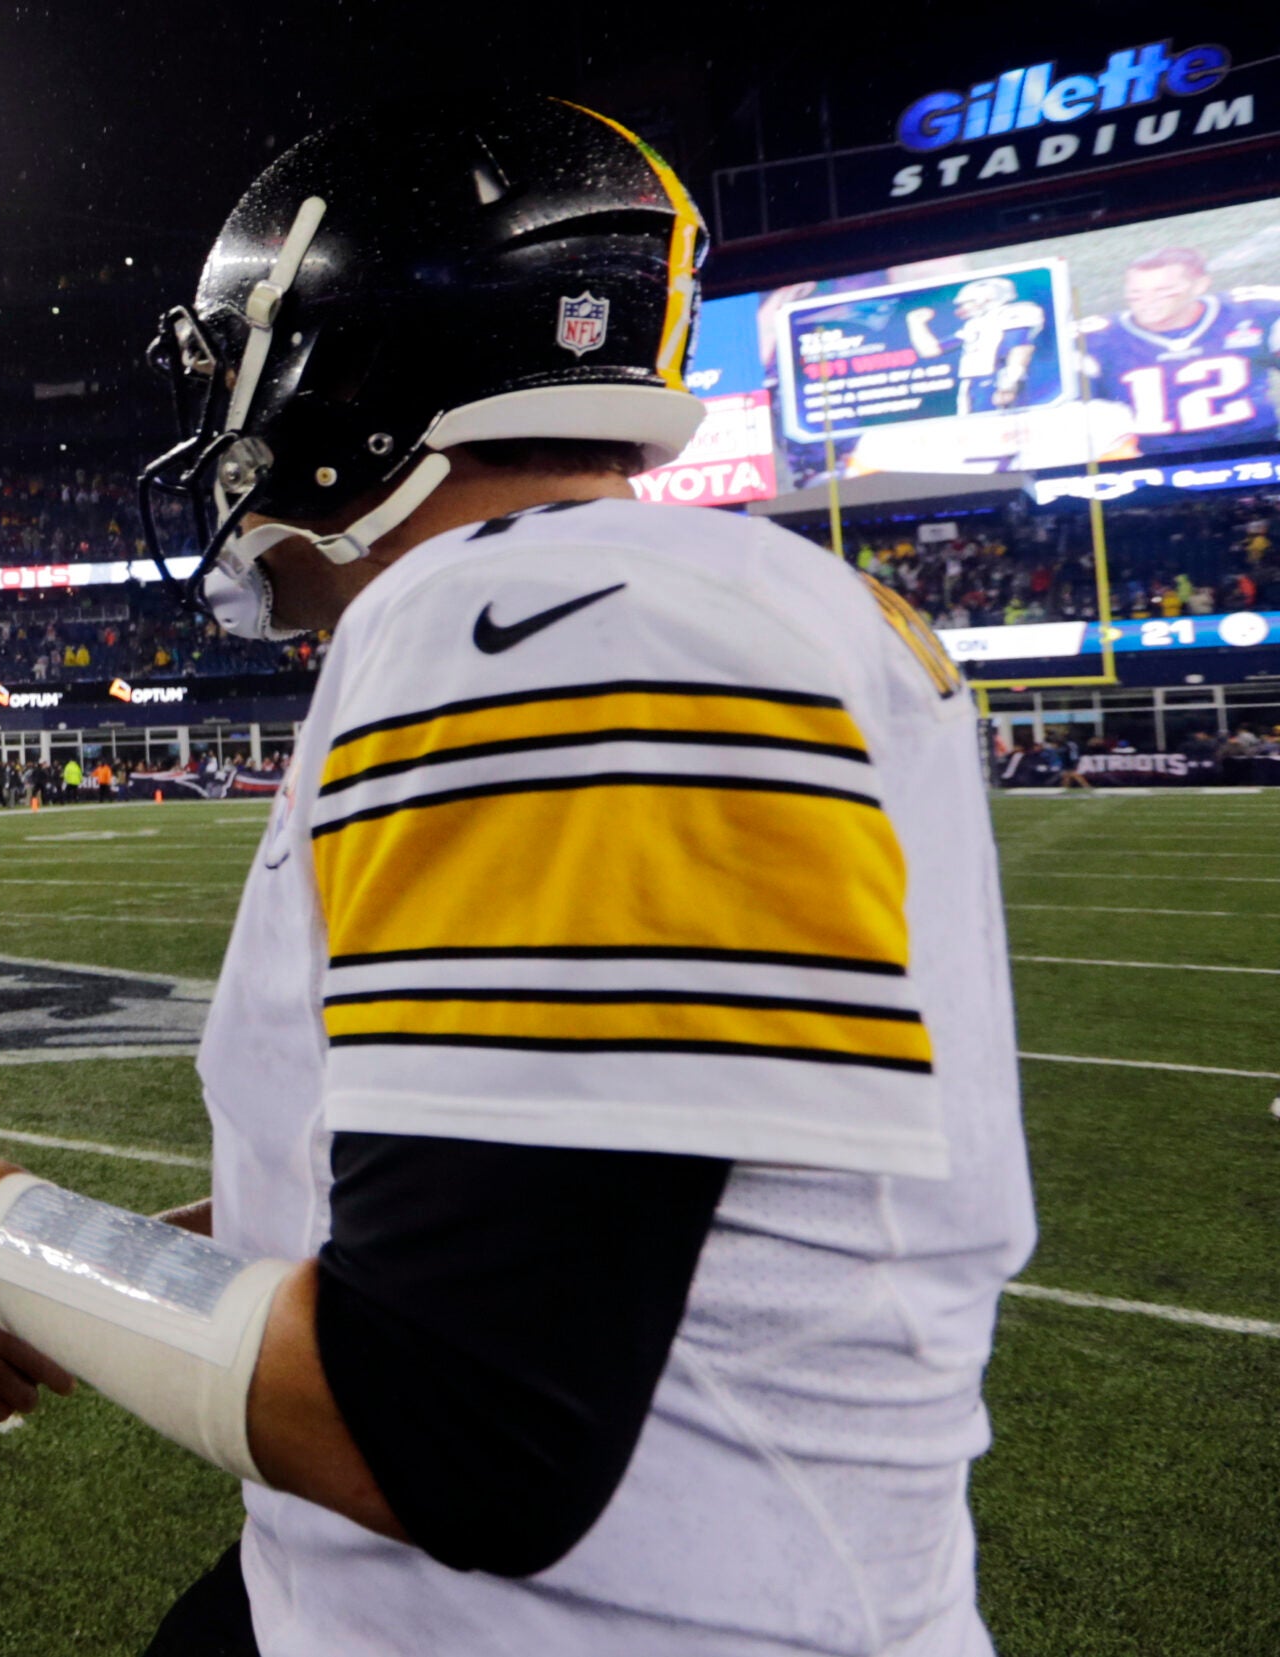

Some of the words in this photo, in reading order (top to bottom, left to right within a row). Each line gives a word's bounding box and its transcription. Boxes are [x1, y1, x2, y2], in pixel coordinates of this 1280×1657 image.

[898, 42, 1228, 150] Gillette
[890, 95, 1254, 197] STADIUM
[565, 319, 601, 345] NFL
[1121, 355, 1257, 436] 12
[628, 461, 762, 501] YOTA
[1141, 619, 1195, 646] 21
[9, 692, 60, 708] OPTUM
[131, 687, 184, 704] OPTUM
[1075, 753, 1187, 775] ATRIOTS
